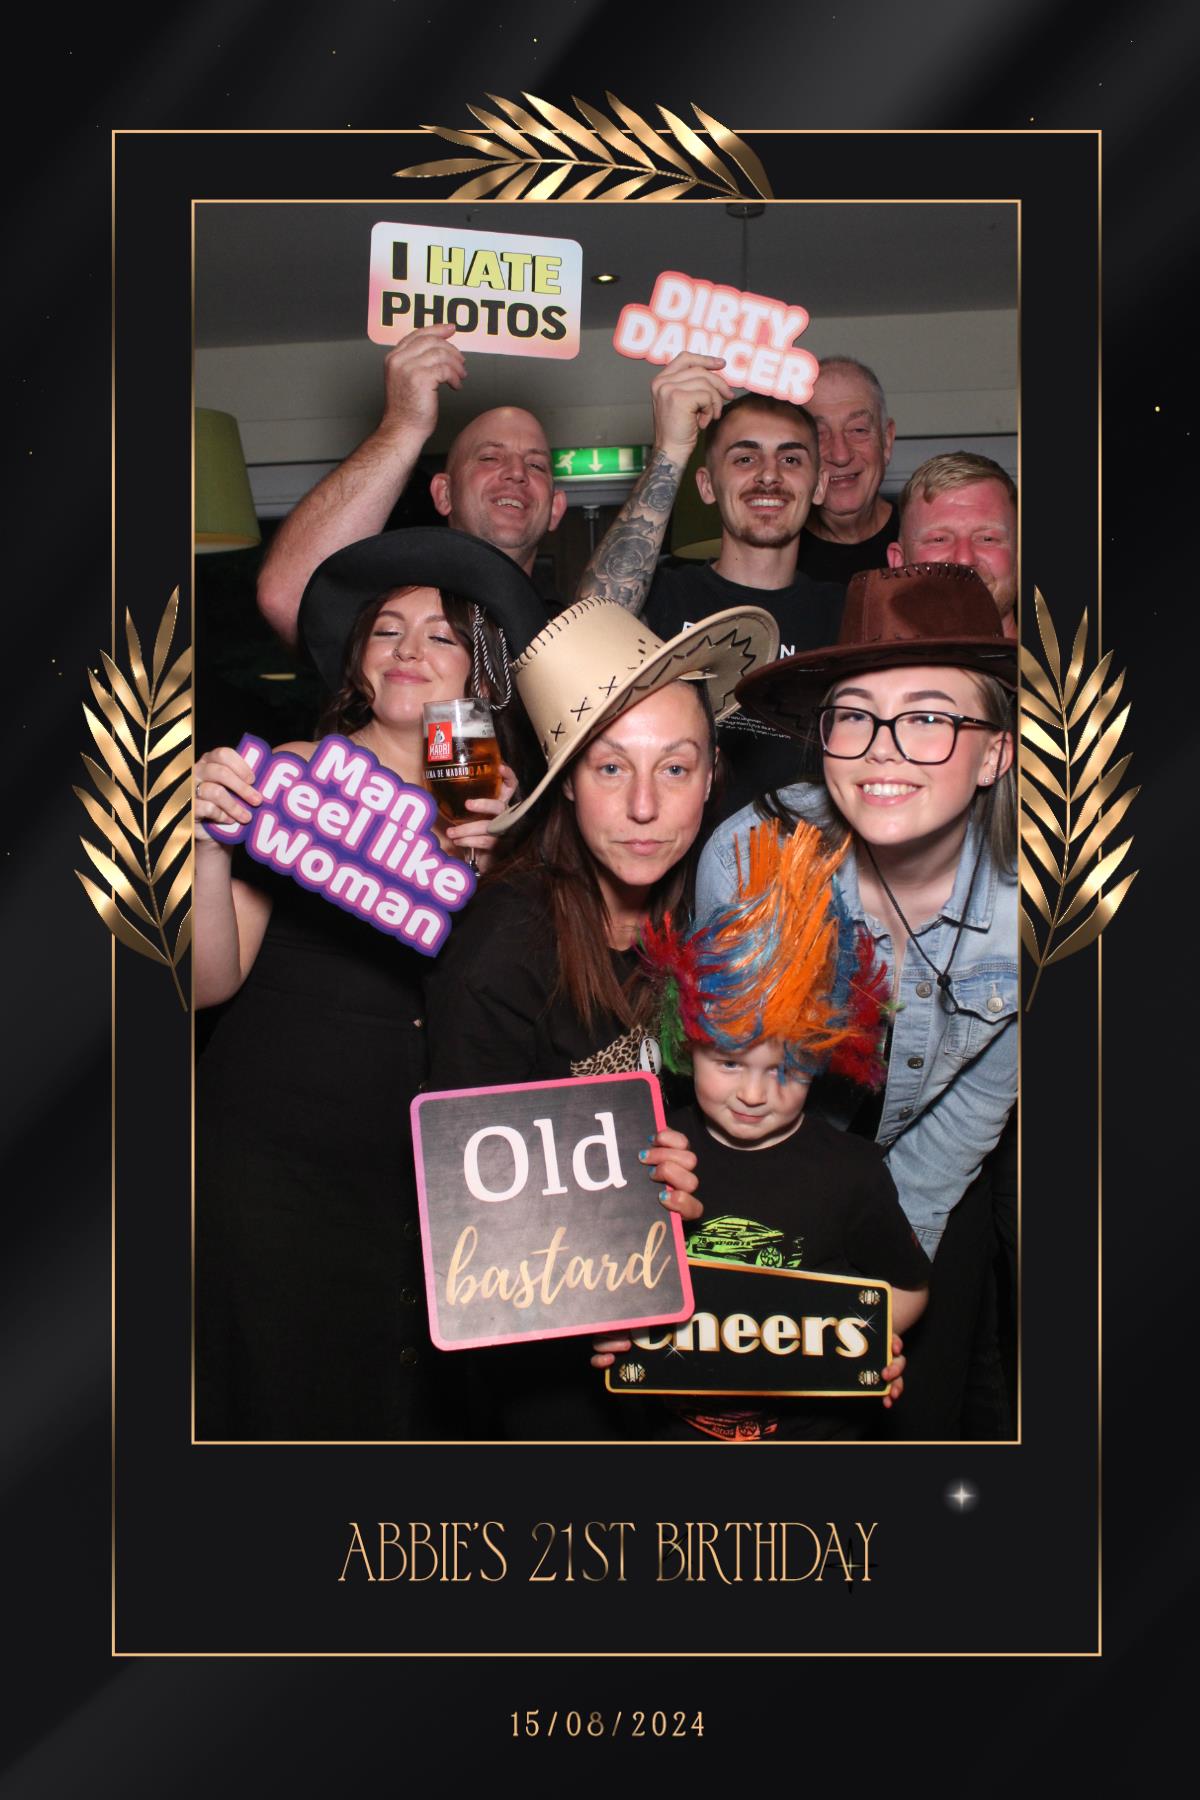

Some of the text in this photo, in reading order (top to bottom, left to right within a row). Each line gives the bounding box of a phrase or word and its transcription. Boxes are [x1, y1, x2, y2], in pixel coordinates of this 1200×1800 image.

[392, 241, 562, 294] I HATE
[381, 291, 567, 341] PHOTOS
[620, 314, 813, 396] DANCER
[656, 280, 804, 346] DIRTY
[315, 744, 427, 831] Man
[446, 766, 469, 777] MADRID
[262, 762, 372, 847] feel
[371, 822, 466, 901] like
[255, 814, 442, 945] woman
[463, 1111, 628, 1203] Old
[446, 1220, 672, 1309] bastard
